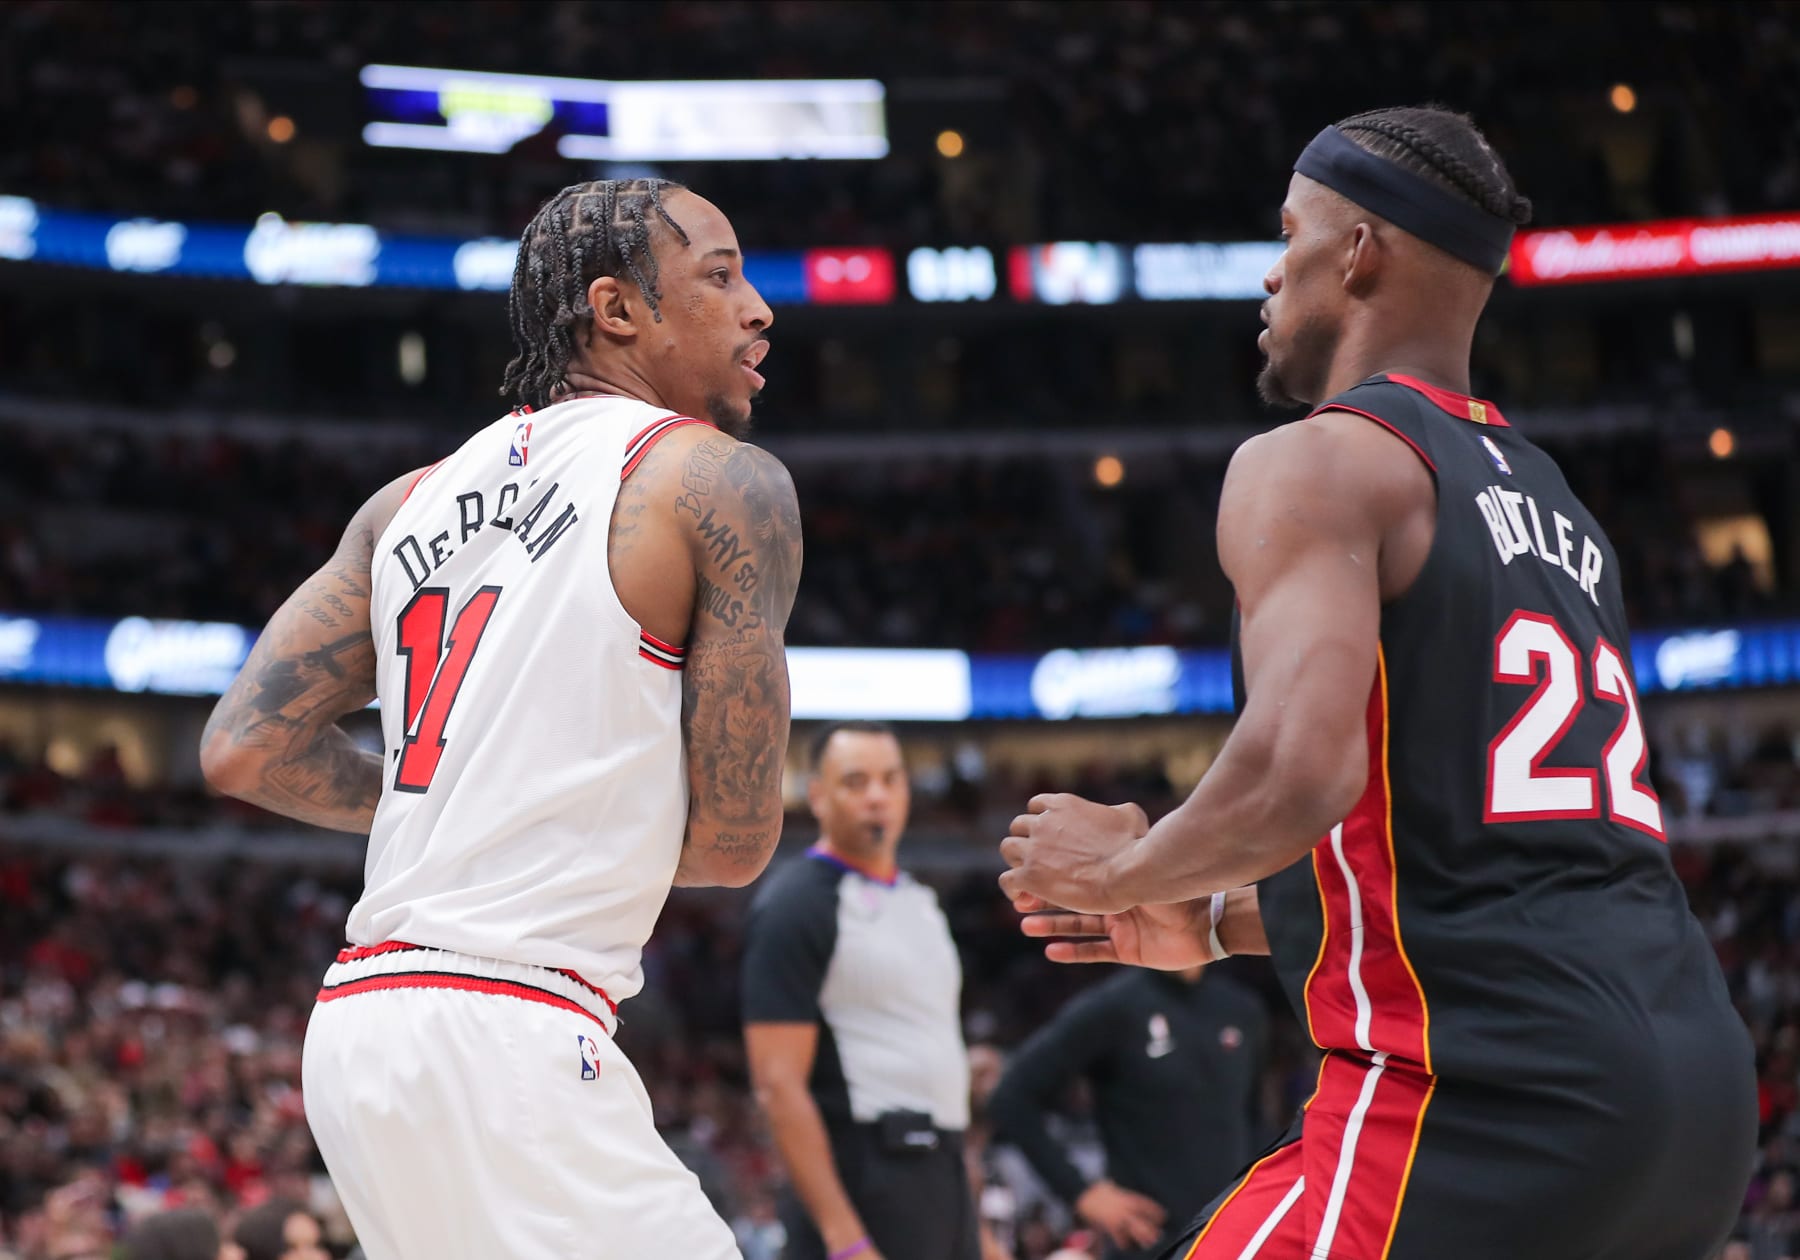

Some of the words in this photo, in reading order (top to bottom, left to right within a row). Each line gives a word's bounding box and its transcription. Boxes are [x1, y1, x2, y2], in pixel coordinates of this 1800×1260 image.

[696, 508, 752, 573] WHY
[733, 561, 759, 593] SO
[1475, 485, 1605, 607] BUTLER
[393, 584, 504, 795] 11
[1482, 608, 1669, 843] 22
